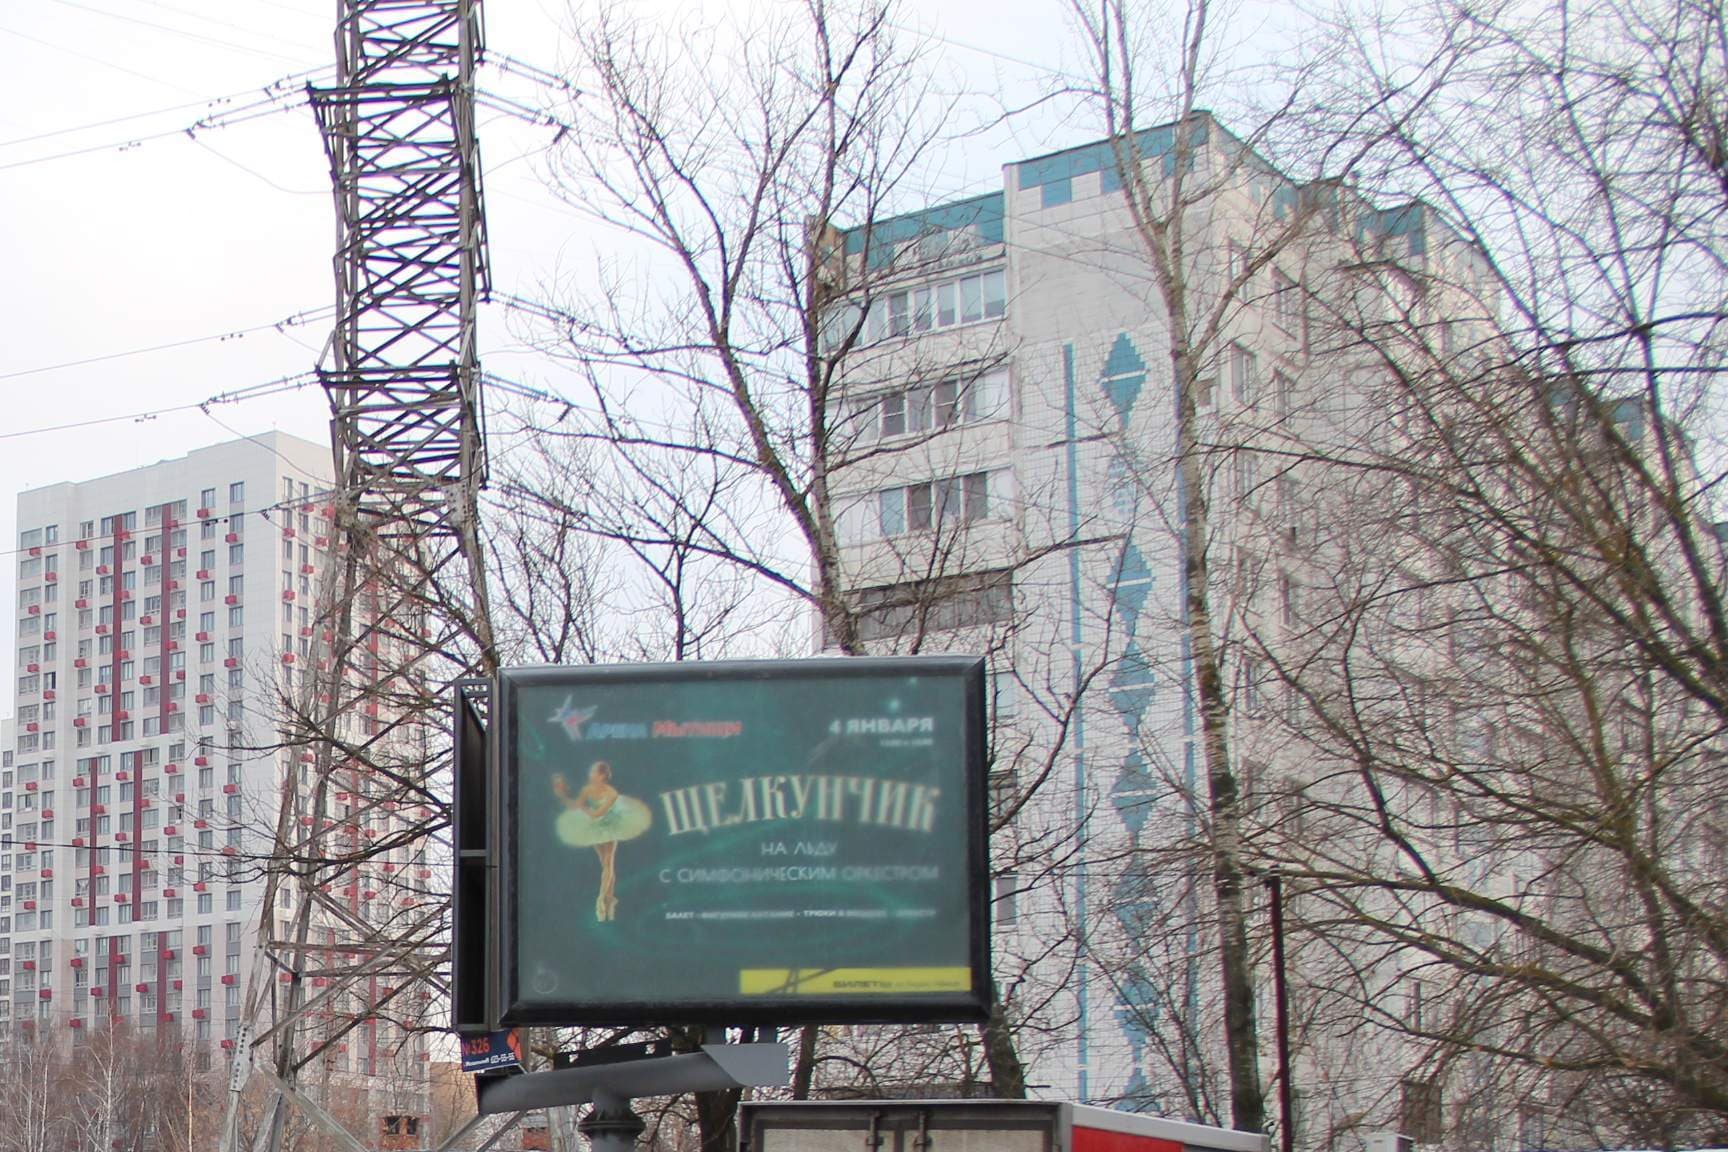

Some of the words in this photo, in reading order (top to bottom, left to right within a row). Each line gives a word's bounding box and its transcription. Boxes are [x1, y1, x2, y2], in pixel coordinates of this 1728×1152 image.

[829, 719, 841, 735] 4
[846, 717, 934, 735] ЯНВАРЯ
[658, 774, 942, 836] ЩЕЛКУНЧИК
[761, 841, 788, 856] НА
[793, 841, 839, 857] ЛЬДУ
[658, 869, 672, 884] С
[676, 866, 837, 883] СИМФОНИЧЕСКИМ
[841, 865, 940, 882] ОРКЕСТРОМ
